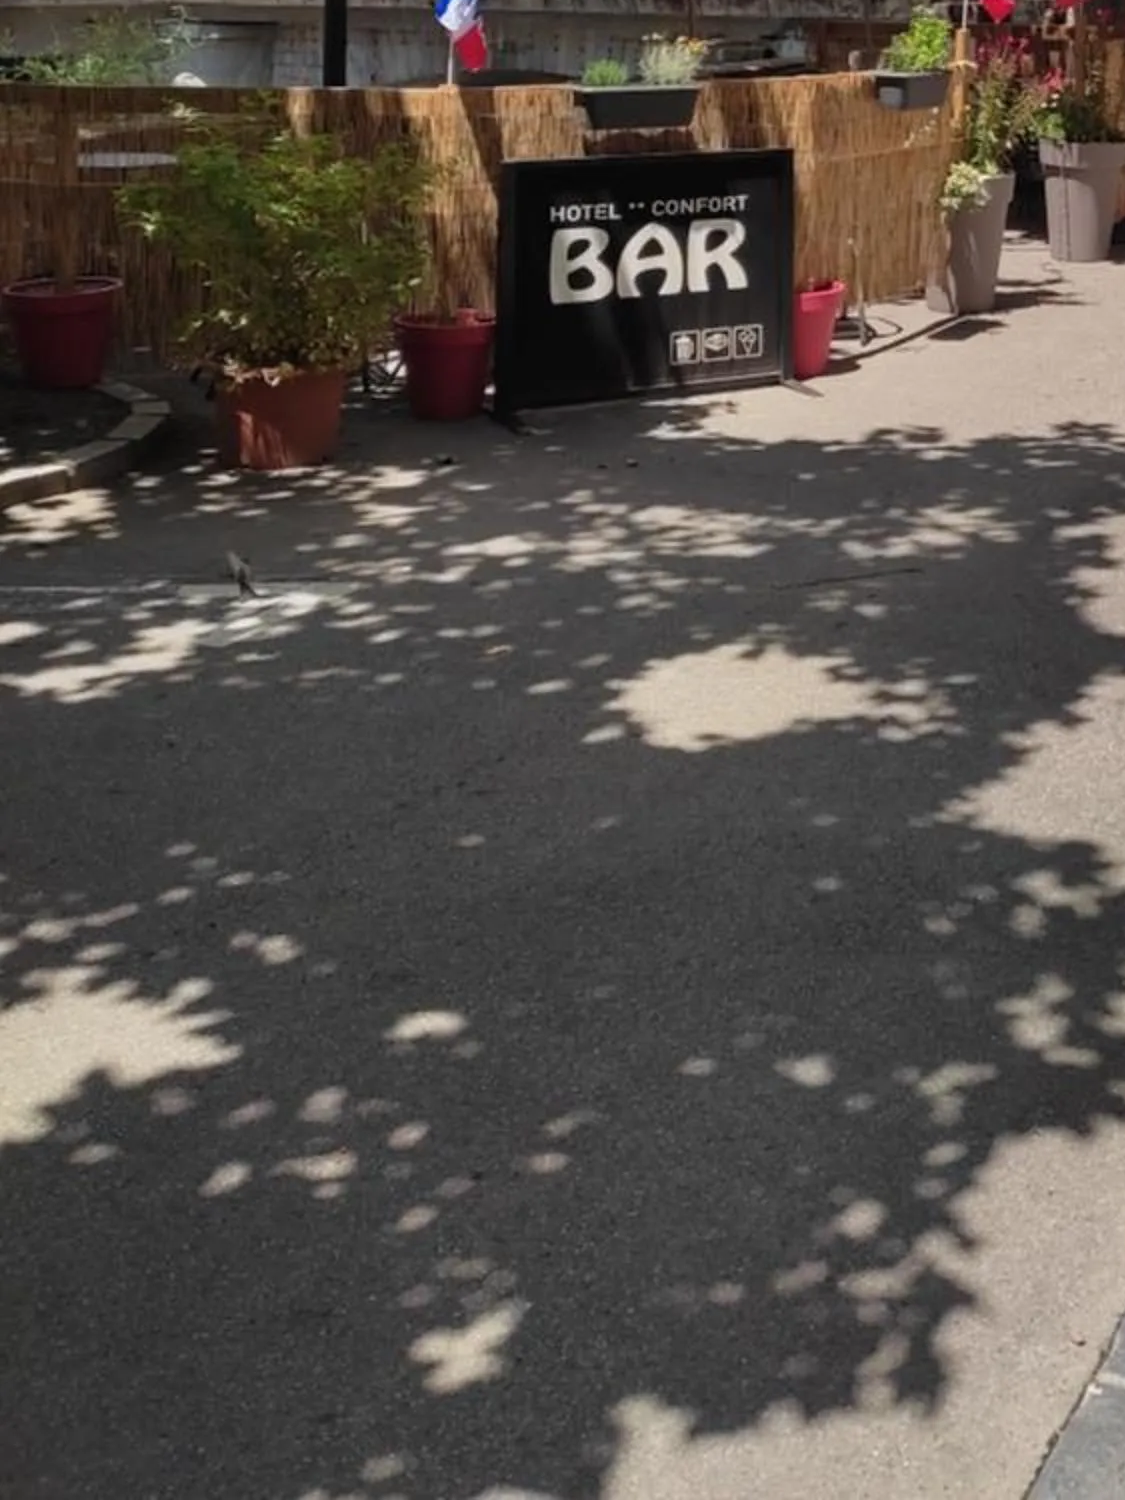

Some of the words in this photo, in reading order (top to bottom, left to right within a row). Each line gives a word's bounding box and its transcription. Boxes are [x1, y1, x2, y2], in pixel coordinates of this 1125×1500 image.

[549, 203, 622, 223] HOTEL
[651, 194, 750, 216] CONFORT
[549, 218, 749, 305] BAR
